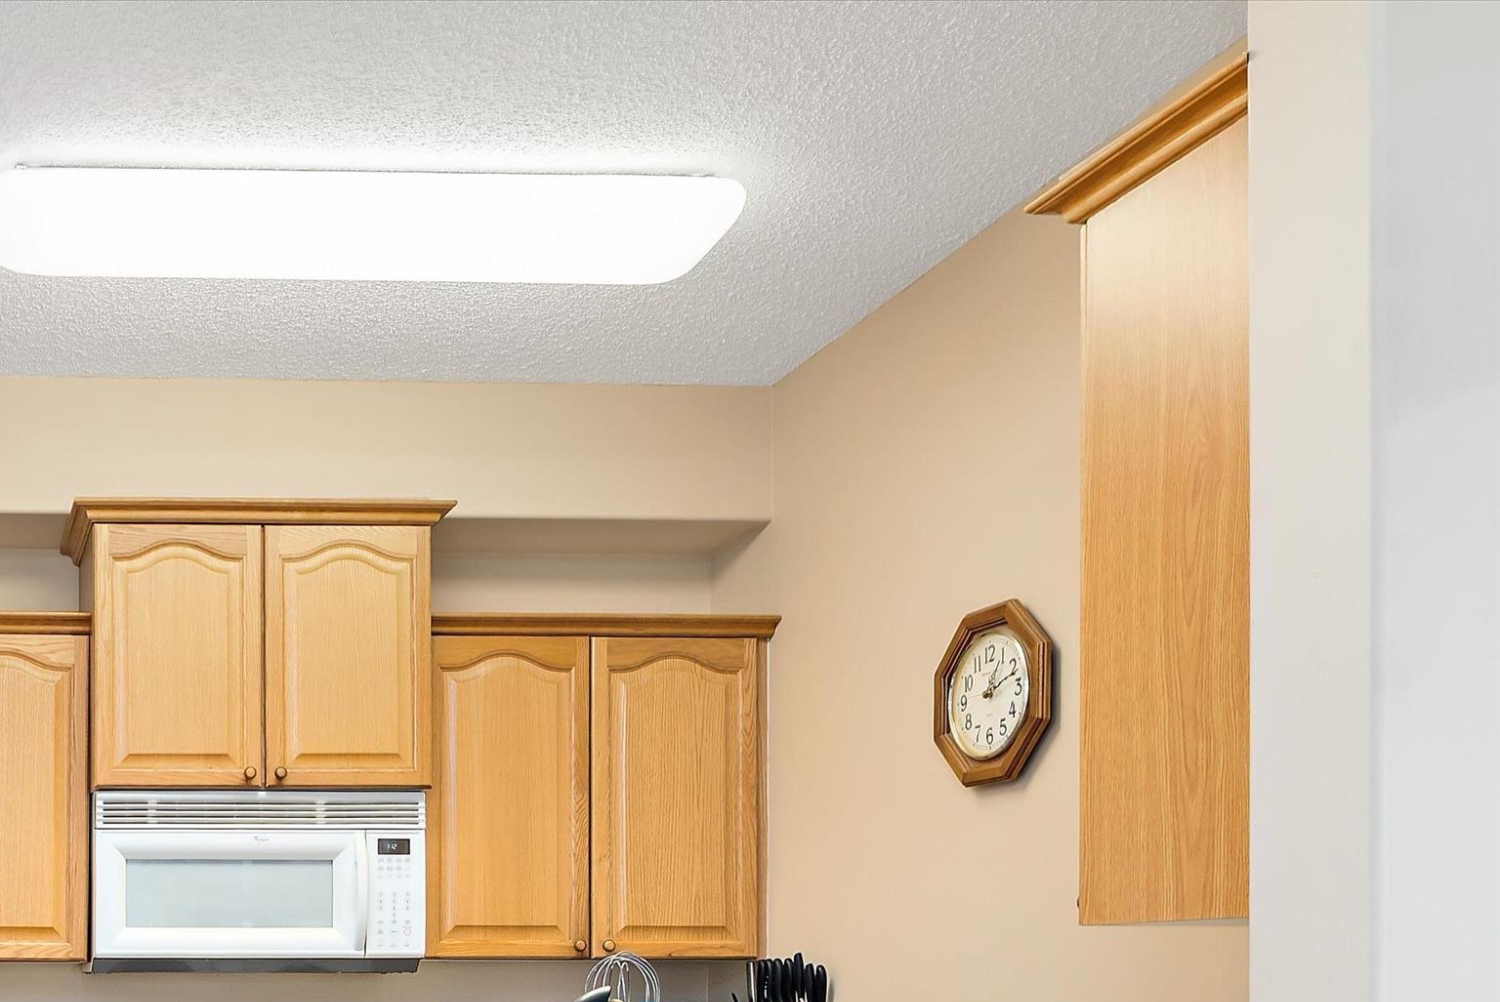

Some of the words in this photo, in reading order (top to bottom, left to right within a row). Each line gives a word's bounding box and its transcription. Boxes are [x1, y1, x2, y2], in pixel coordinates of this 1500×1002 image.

[984, 644, 995, 664] 12
[1000, 647, 1005, 664] 1
[973, 655, 981, 673] 11
[1010, 658, 1019, 674] 2
[964, 675, 973, 692] 10
[1015, 677, 1023, 696] 3
[961, 695, 967, 713] 9
[1009, 700, 1016, 717] 4
[965, 713, 972, 730] 8
[999, 718, 1007, 736] 5
[975, 725, 981, 743] 7
[986, 728, 994, 745] 6
